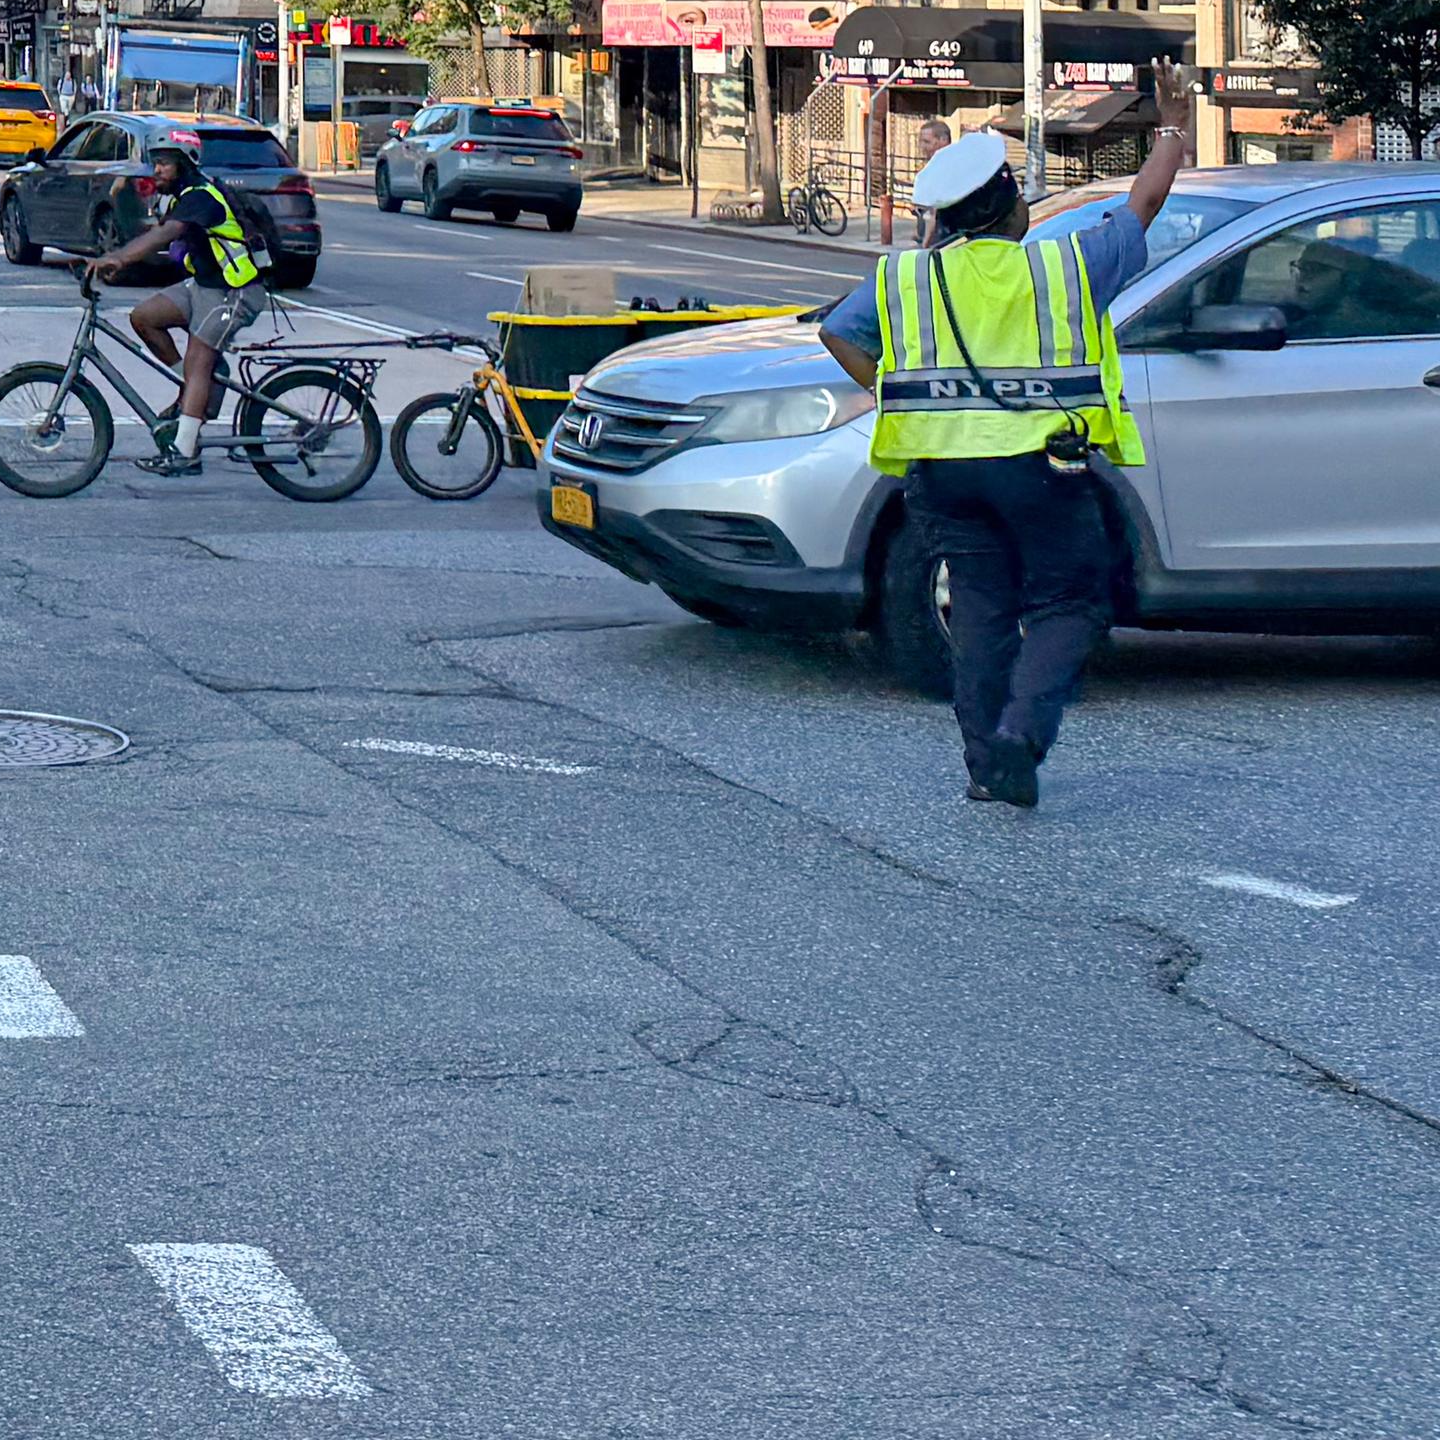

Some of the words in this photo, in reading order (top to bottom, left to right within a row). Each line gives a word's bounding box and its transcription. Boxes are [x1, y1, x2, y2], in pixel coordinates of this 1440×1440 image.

[929, 40, 961, 57] 649
[903, 66, 930, 78] Hair
[931, 66, 965, 79] Salon
[928, 379, 1054, 399] NYPD
